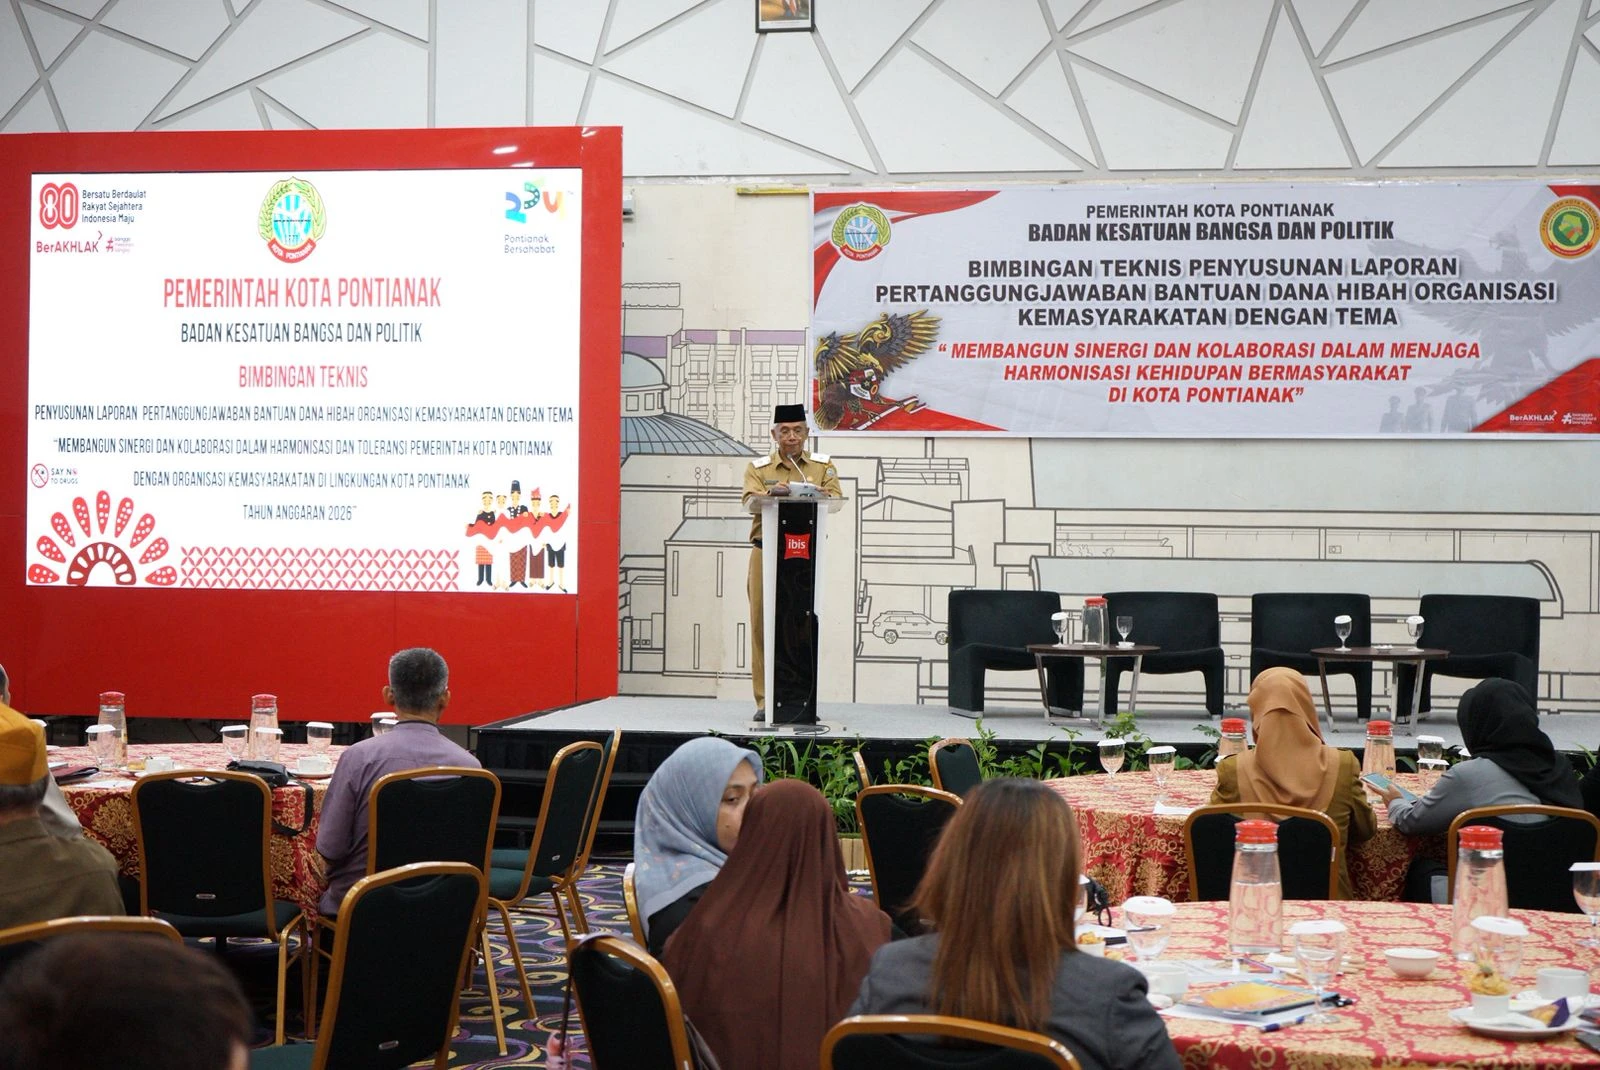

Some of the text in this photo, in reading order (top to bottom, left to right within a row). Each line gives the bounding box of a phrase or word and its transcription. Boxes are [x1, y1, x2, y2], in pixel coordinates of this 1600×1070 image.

[82, 190, 146, 199] Bersatu Berdaulat
[39, 182, 79, 230] 80
[82, 202, 142, 212] Rakyat Sejahtera
[1086, 203, 1334, 218] PEMERINTAH KOTA PONTIANAK
[82, 214, 134, 224] Indonesia Maju
[504, 234, 550, 243] Pontianak
[1028, 221, 1394, 242] BADAN KESATUAN BANGSA DAN POLITIK
[36, 240, 99, 253] BerAKHLAK
[504, 244, 556, 254] Bersahabat
[968, 258, 1457, 278] BIMBINGAN TEKNIS PENYUSUNAN LAPORAN
[164, 277, 441, 308] PEMERINTAH KOTA PONTIANAK
[876, 282, 1554, 303] PERTANGGUNGJAWABAN BANTUAN DANA HIBAH ORGANISASI
[1018, 307, 1398, 326] KEMASYARAKATAN DENGAN TEMA
[181, 322, 422, 342] BADAN KESATUAN BANGSA DAN POLITIK
[951, 344, 1072, 358] MEMBANGUN
[1074, 344, 1148, 358] SINERGI
[1153, 343, 1192, 358] DAN
[1196, 343, 1315, 358] KOLABORASI
[1320, 342, 1384, 358] DALAM
[1390, 342, 1480, 358] MENJAGA
[239, 365, 368, 388] BIMBINGAN TEKNIS
[1004, 364, 1412, 380] HARMONISASI KEHIDUPAN BERMASYARAKAT
[1108, 387, 1126, 403] DI
[1132, 387, 1180, 403] KOTA
[35, 405, 574, 422] PENYUSUNAN LAPORAN PERTANGGUNGJAWABAN BANTUAN DANA HIBAH ORGANISASI KEMASYARAKATAN DENGAN TEMA
[119, 438, 154, 453] SINERGI
[156, 438, 174, 454] DAN
[178, 438, 233, 454] KOLABORASI
[236, 439, 268, 454] DALAM
[271, 439, 333, 454] HARMONISASI
[336, 439, 354, 454] DAN
[358, 440, 408, 455] TOLERANSI
[410, 440, 470, 455] PEMERINTAH
[472, 440, 497, 455] KOTA
[500, 440, 553, 455] PONTIANAK
[134, 471, 470, 488] DENGAN ORGANISASI KEMASYARAKATAN DI LINGKUNGAN KOTA PONTIANAK
[243, 505, 273, 520] TAHUN
[276, 505, 325, 520] ANGGARAN
[788, 538, 806, 550] ibis
